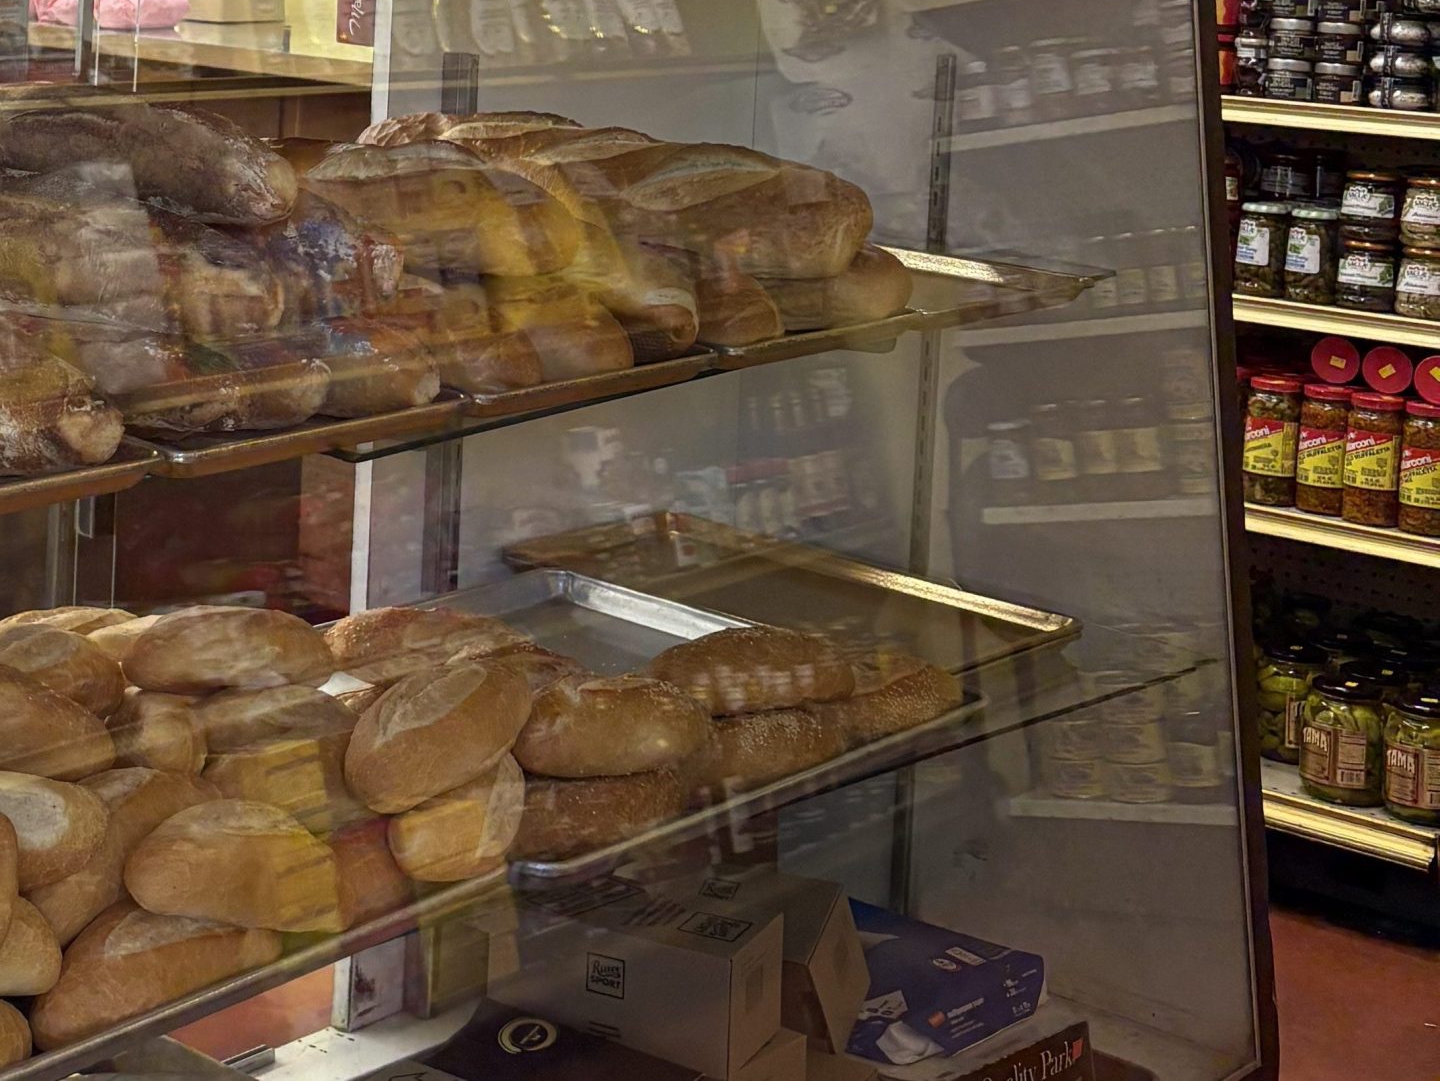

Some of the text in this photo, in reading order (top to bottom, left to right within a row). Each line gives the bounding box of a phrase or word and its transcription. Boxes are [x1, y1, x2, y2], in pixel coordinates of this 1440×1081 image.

[1303, 726, 1327, 752] TAMA
[1387, 749, 1415, 774] TAMA
[591, 975, 621, 989] SPORT
[1041, 1040, 1072, 1081] Park
